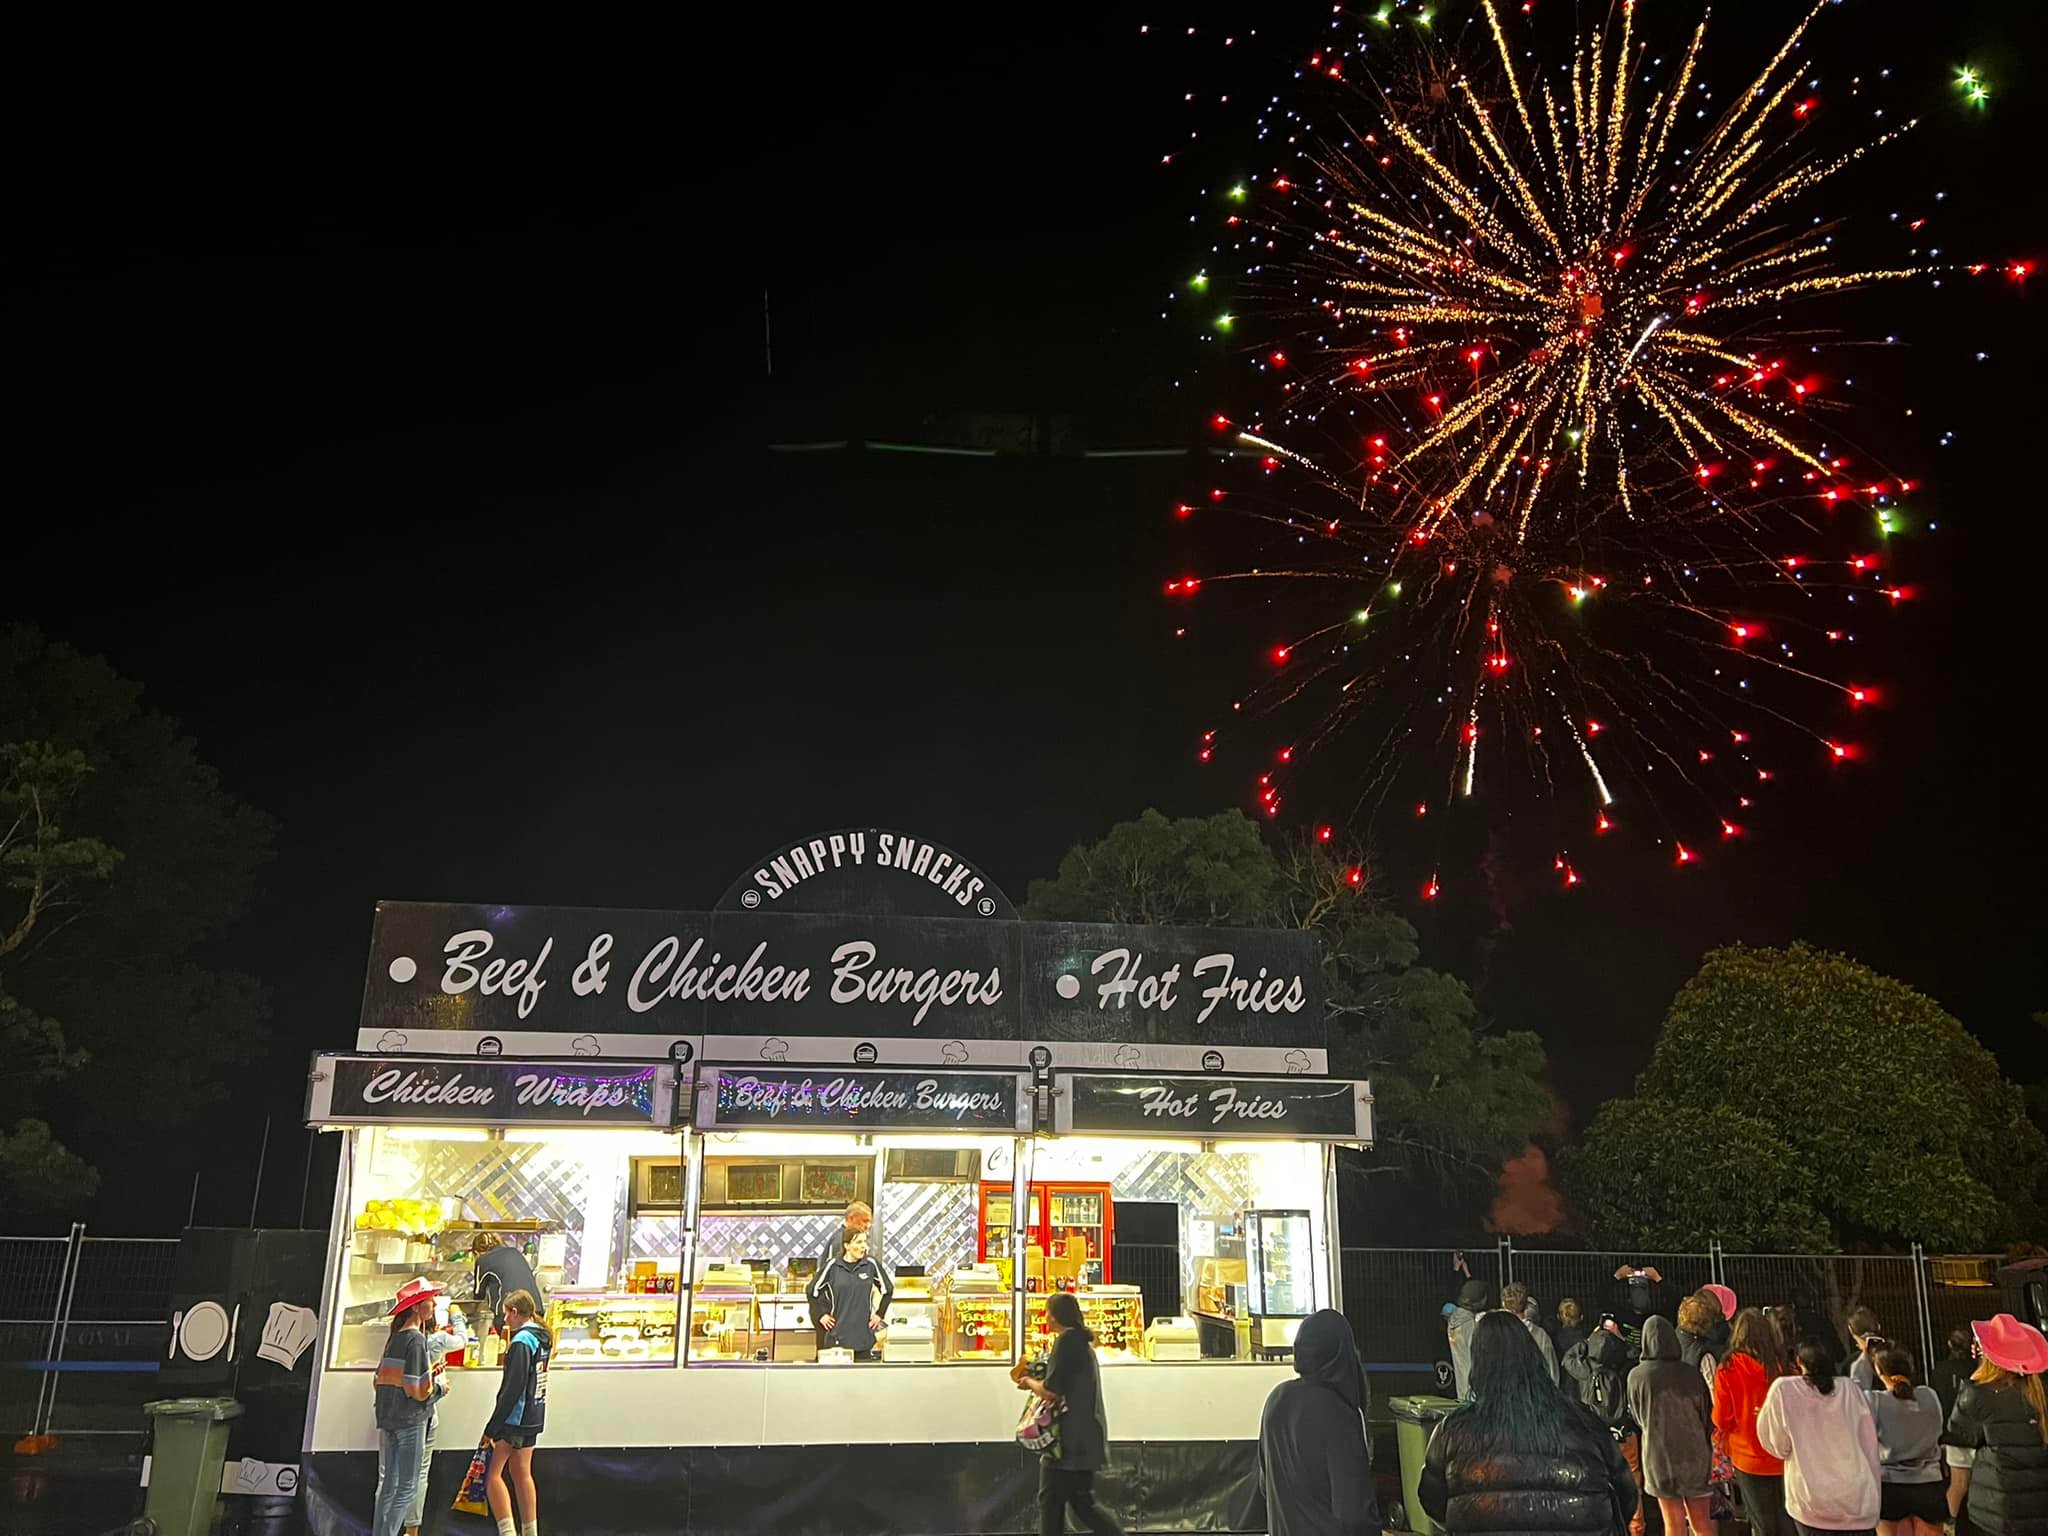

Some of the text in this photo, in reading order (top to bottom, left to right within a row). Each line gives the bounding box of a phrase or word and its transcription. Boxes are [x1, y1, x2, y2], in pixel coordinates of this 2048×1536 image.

[753, 832, 985, 907] SNAPPY SNACKS
[440, 929, 1003, 1027] Beef & Chicken Burgers
[1090, 948, 1306, 1024] Hot Fries
[362, 1069, 628, 1116] Chicken Wraps
[735, 1075, 1003, 1120] Beef & Chicken Burgers
[1139, 1086, 1288, 1124] Hot Fries
